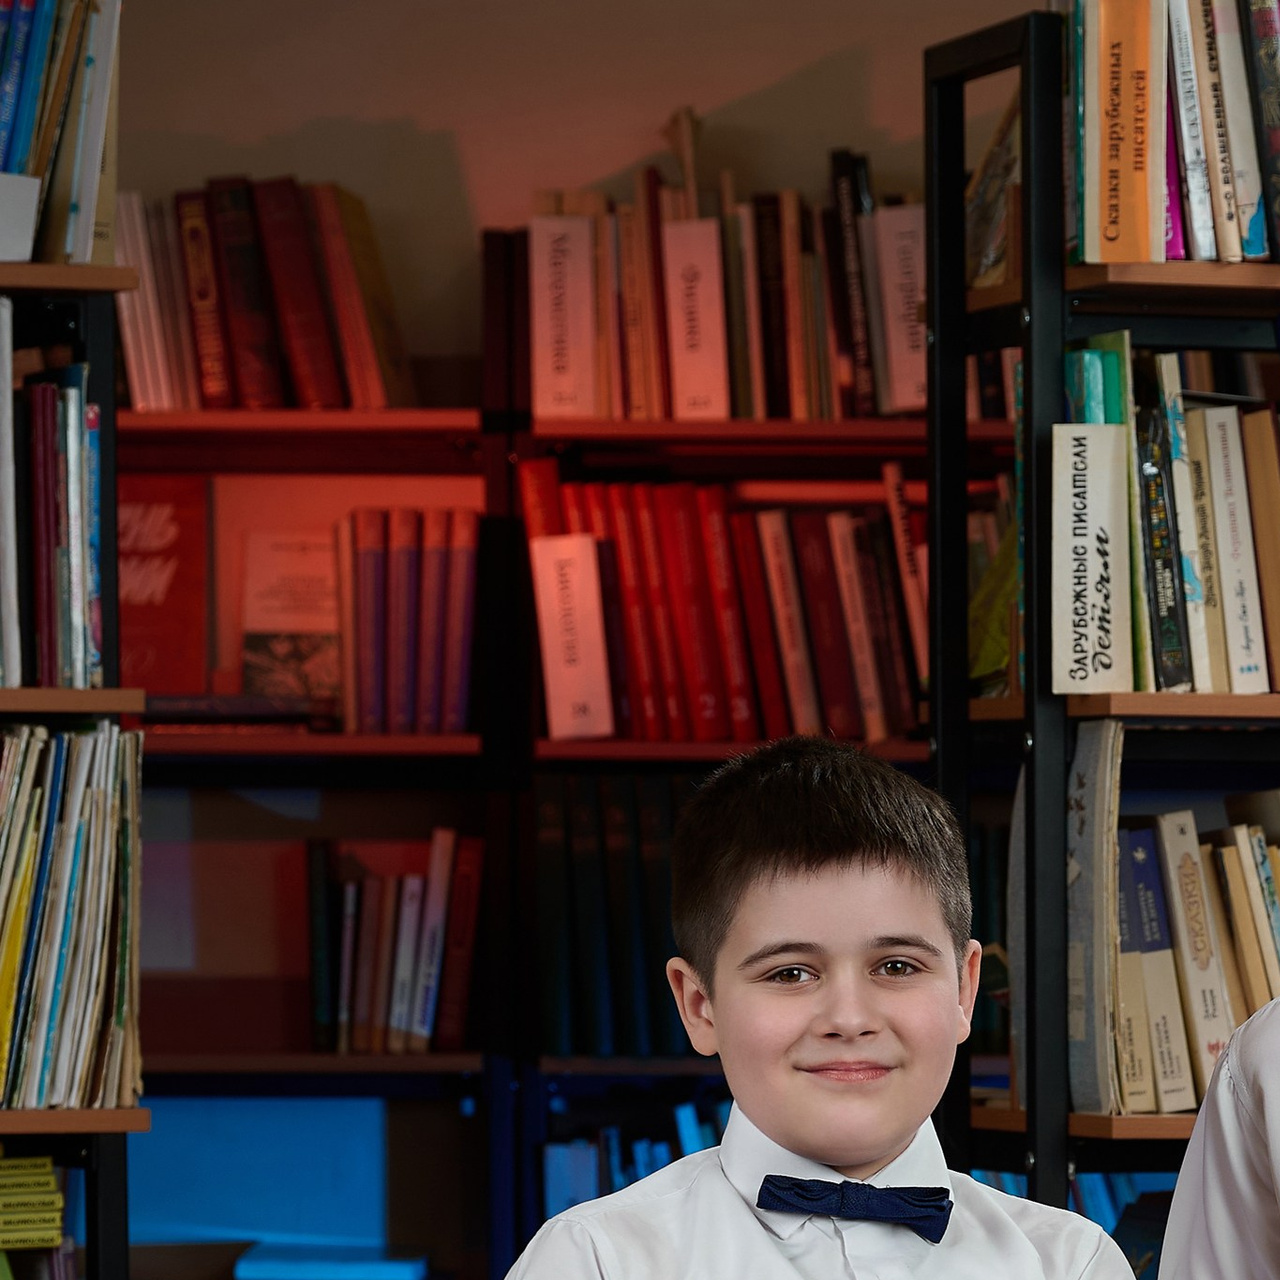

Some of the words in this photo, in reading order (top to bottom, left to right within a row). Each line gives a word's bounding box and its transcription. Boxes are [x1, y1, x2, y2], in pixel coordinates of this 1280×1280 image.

[1102, 40, 1124, 163] зарубежных
[1129, 69, 1147, 171] писателей
[1102, 168, 1120, 241] Сказки
[680, 263, 704, 352] Физика
[1068, 436, 1088, 537] ПИСАТЕЛИ
[1069, 544, 1089, 680] ЗАРУБЕЖНЫЕ
[1087, 525, 1112, 672] детям
[1182, 869, 1207, 954] СКАЗКИ
